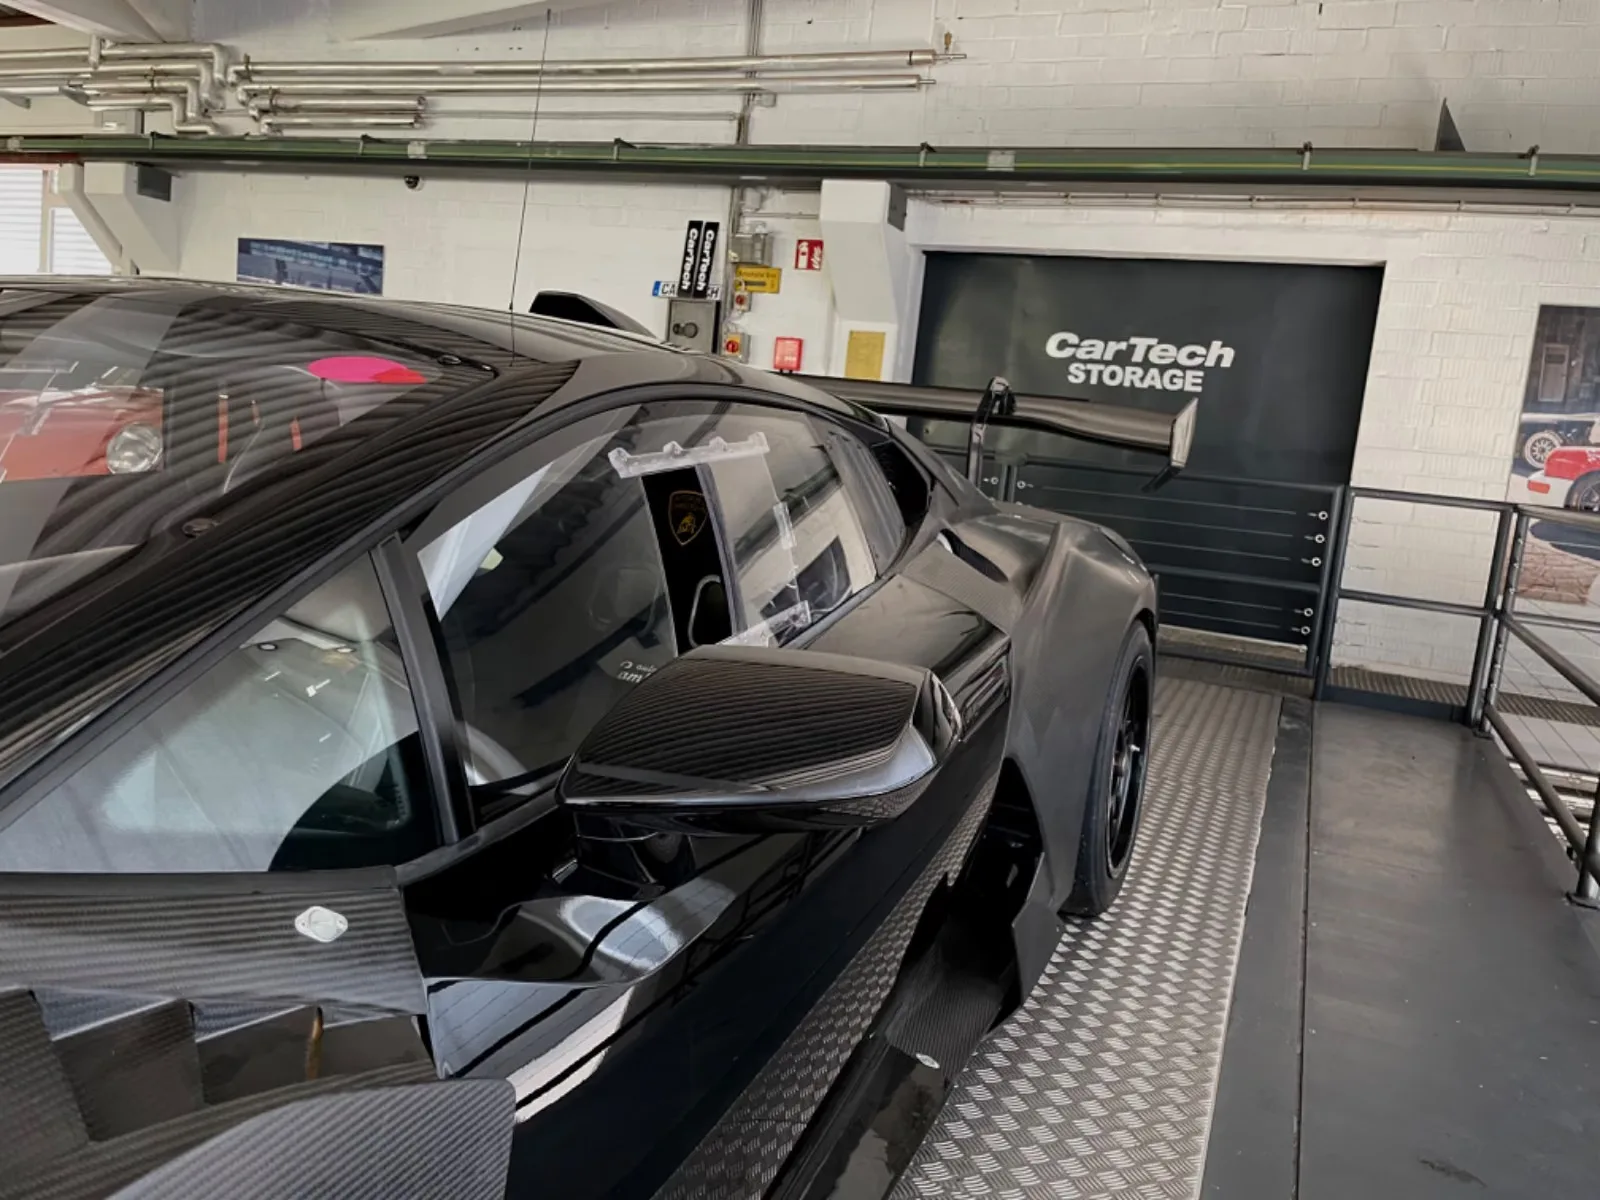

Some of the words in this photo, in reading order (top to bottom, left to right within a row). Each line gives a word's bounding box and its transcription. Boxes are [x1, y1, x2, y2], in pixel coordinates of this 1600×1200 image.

[681, 228, 698, 290] CarTech
[696, 229, 715, 291] CarTech
[1045, 331, 1235, 368] CarTech
[1067, 362, 1205, 392] STORAGE
